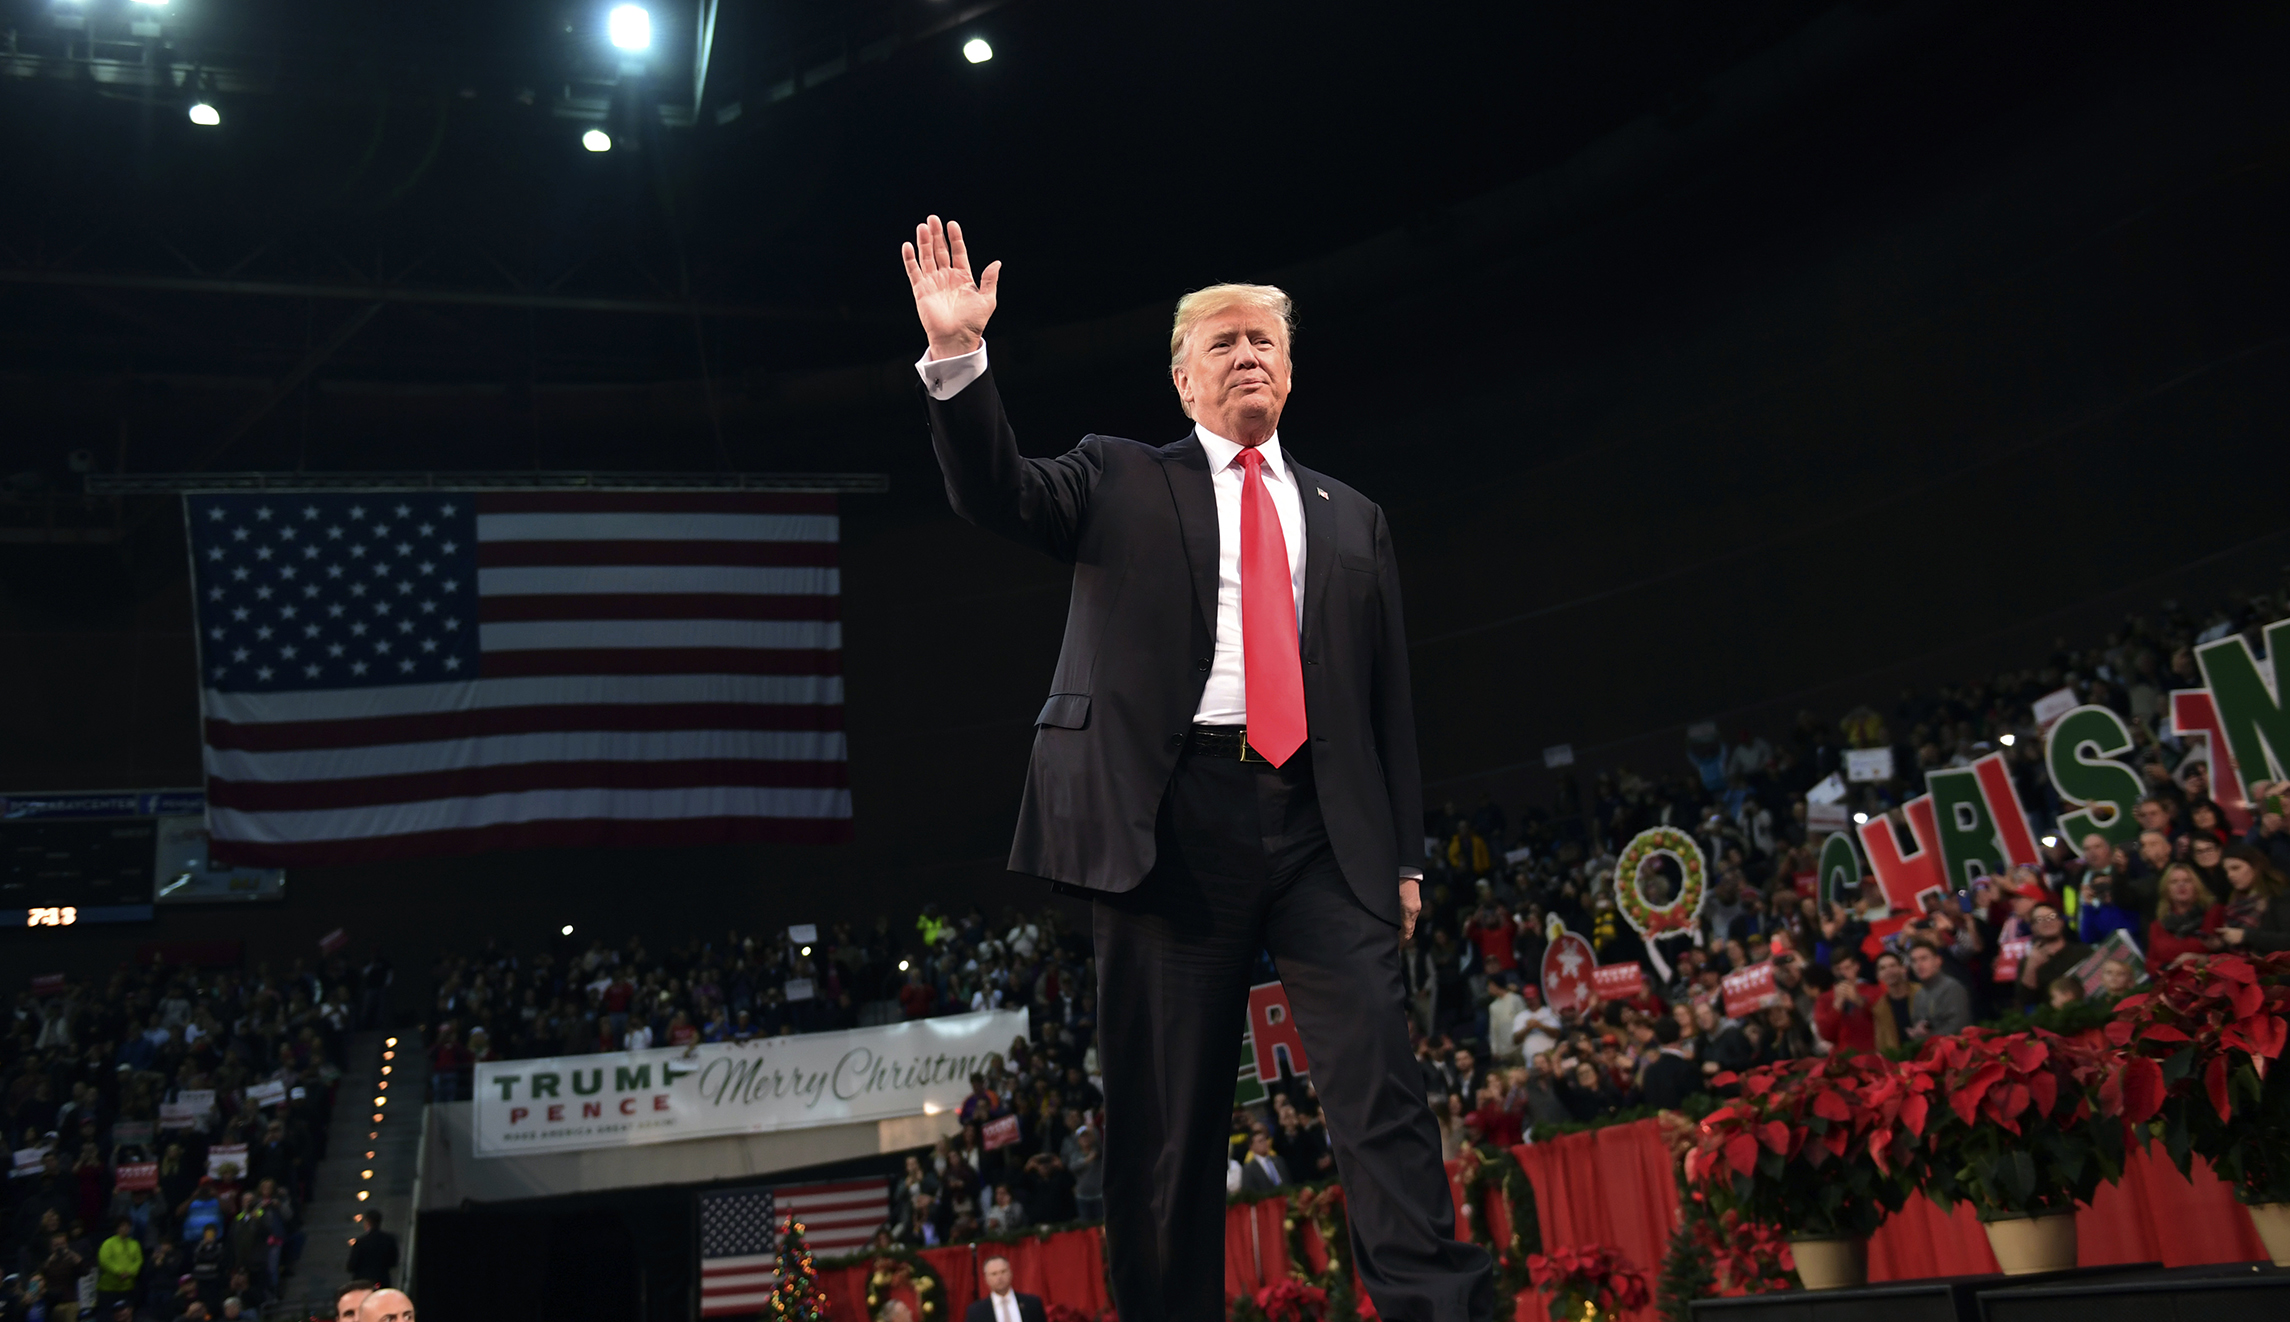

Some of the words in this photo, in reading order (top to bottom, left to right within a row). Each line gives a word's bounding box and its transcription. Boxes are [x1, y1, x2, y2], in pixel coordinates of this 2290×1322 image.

[699, 1056, 828, 1108] Merry
[510, 1093, 671, 1125] PENCE
[540, 1127, 592, 1138] AMERICA
